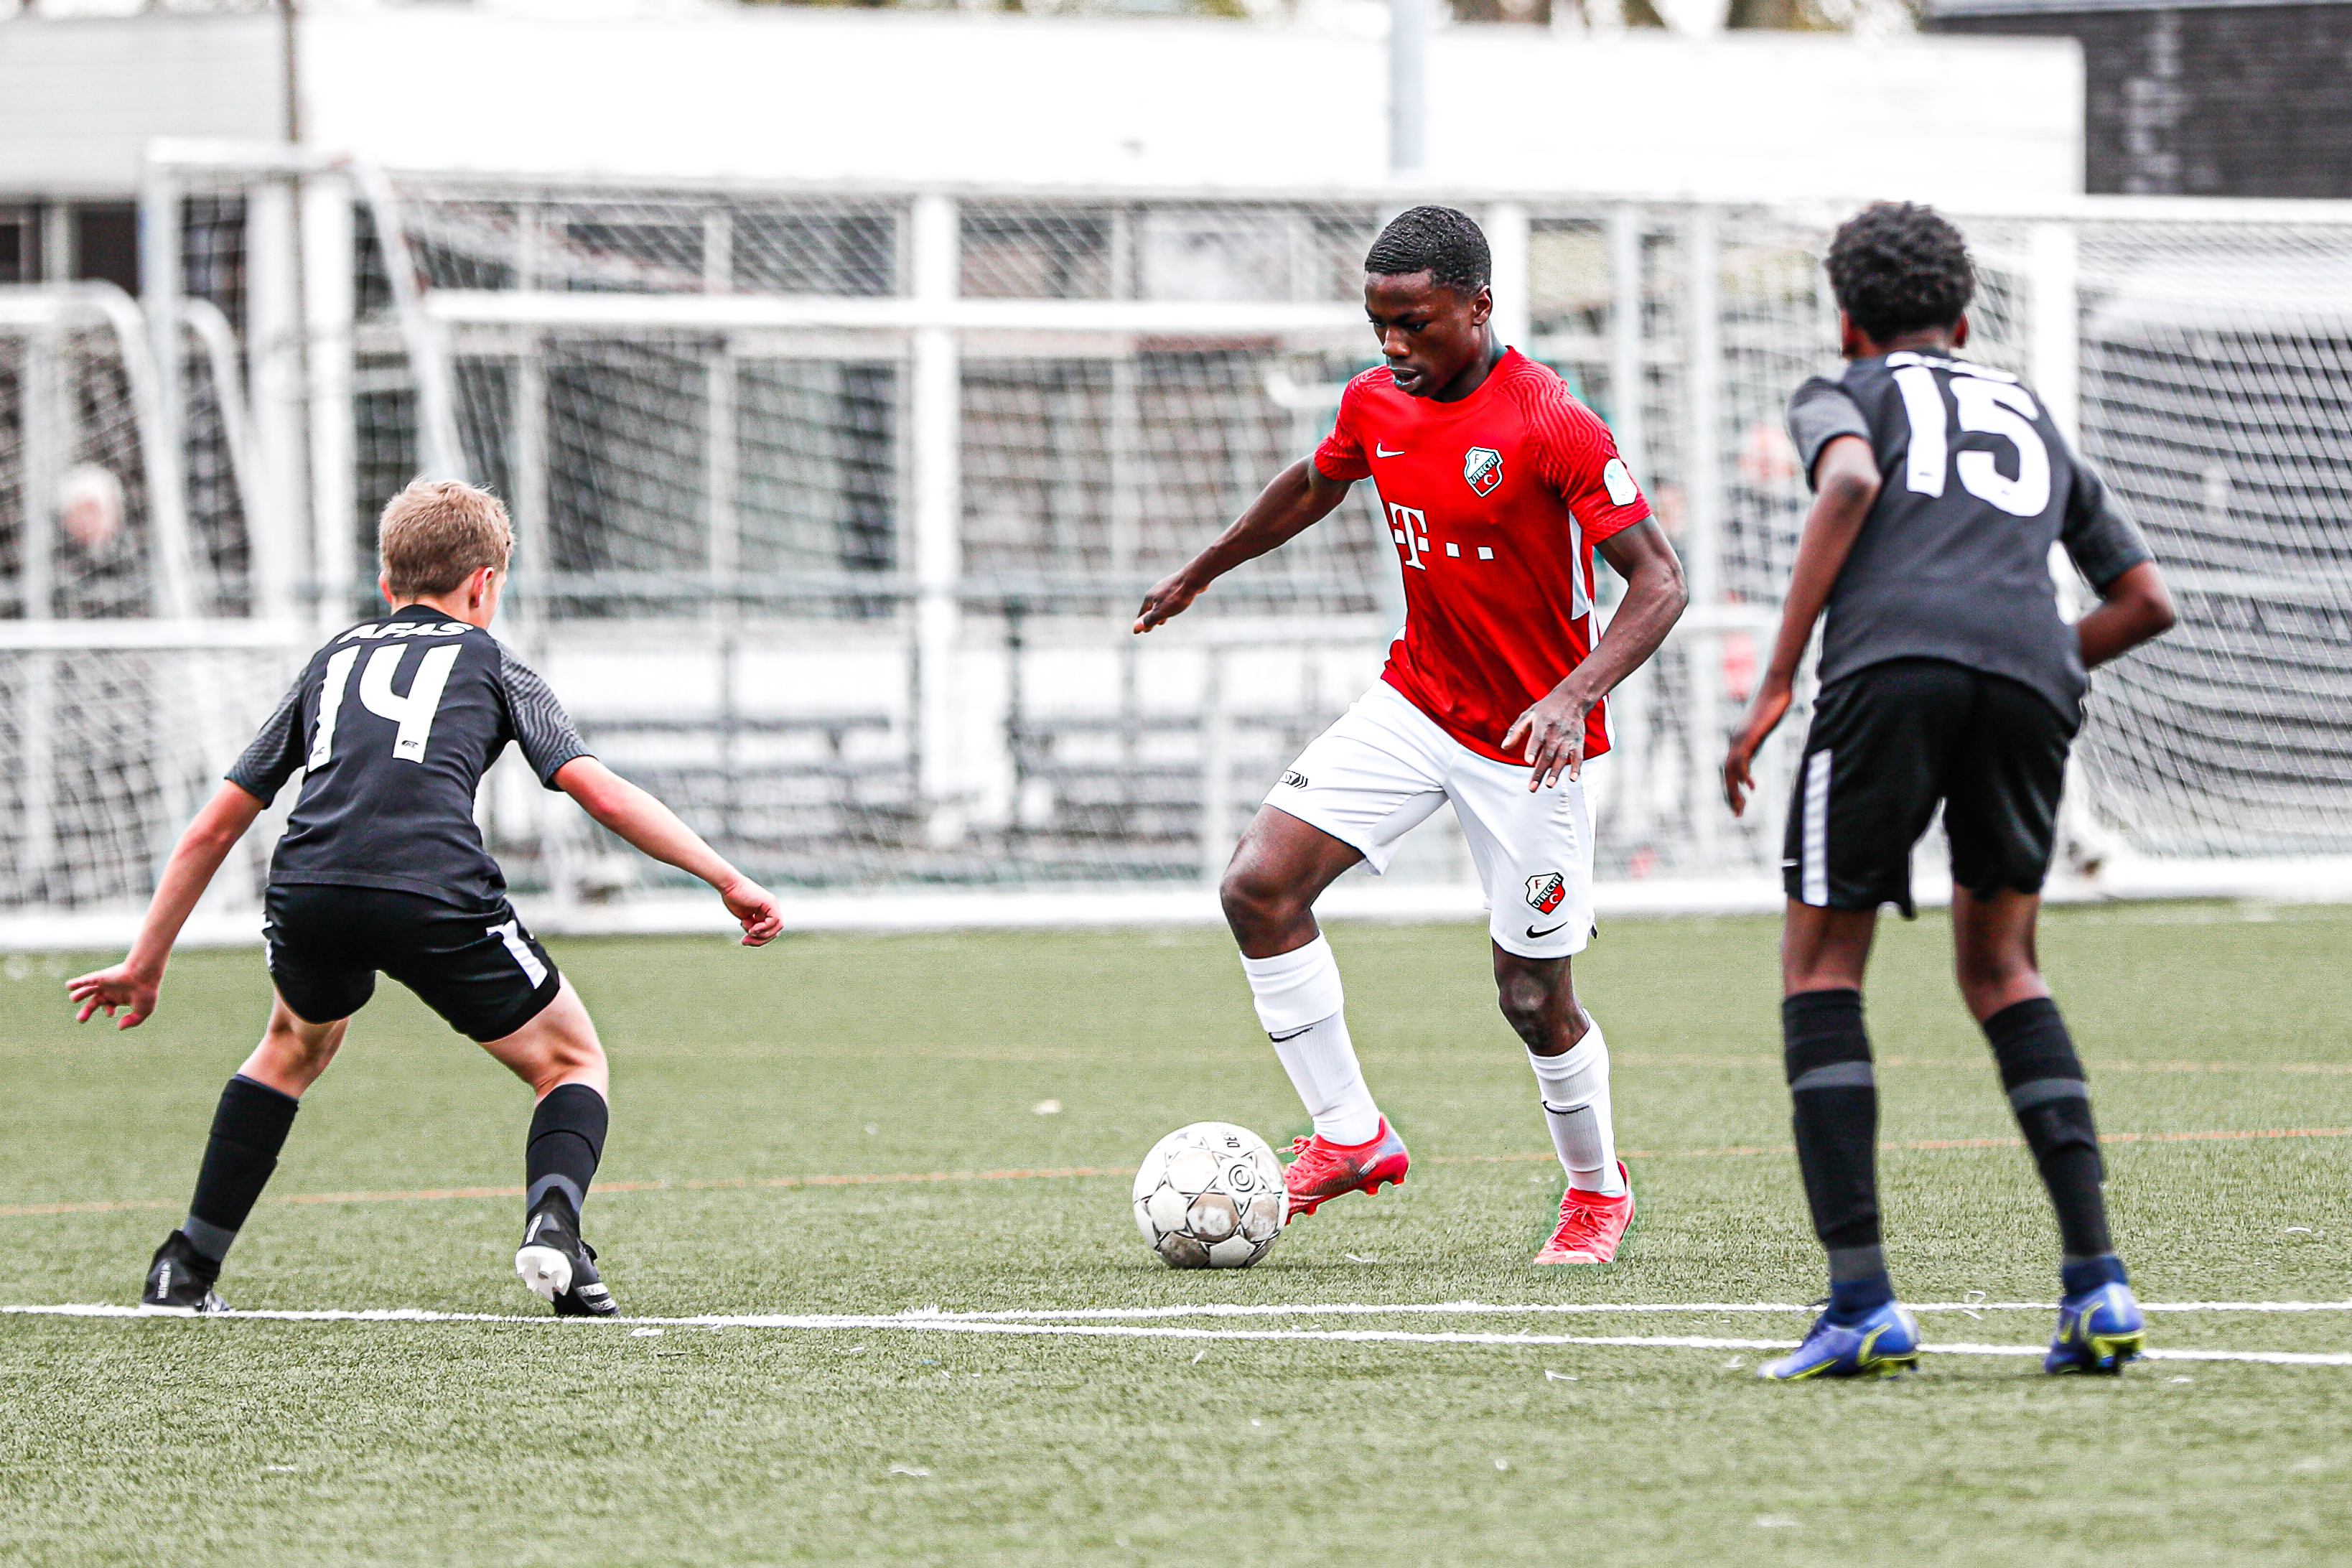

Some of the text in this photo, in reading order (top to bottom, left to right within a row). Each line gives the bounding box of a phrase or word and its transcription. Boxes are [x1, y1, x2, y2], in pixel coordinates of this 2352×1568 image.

[1892, 365, 2051, 517] 15
[1483, 474, 1493, 485] C
[336, 622, 475, 644] AFAS
[307, 643, 463, 773] 14
[1534, 879, 1541, 890] F
[1549, 893, 1559, 904] C
